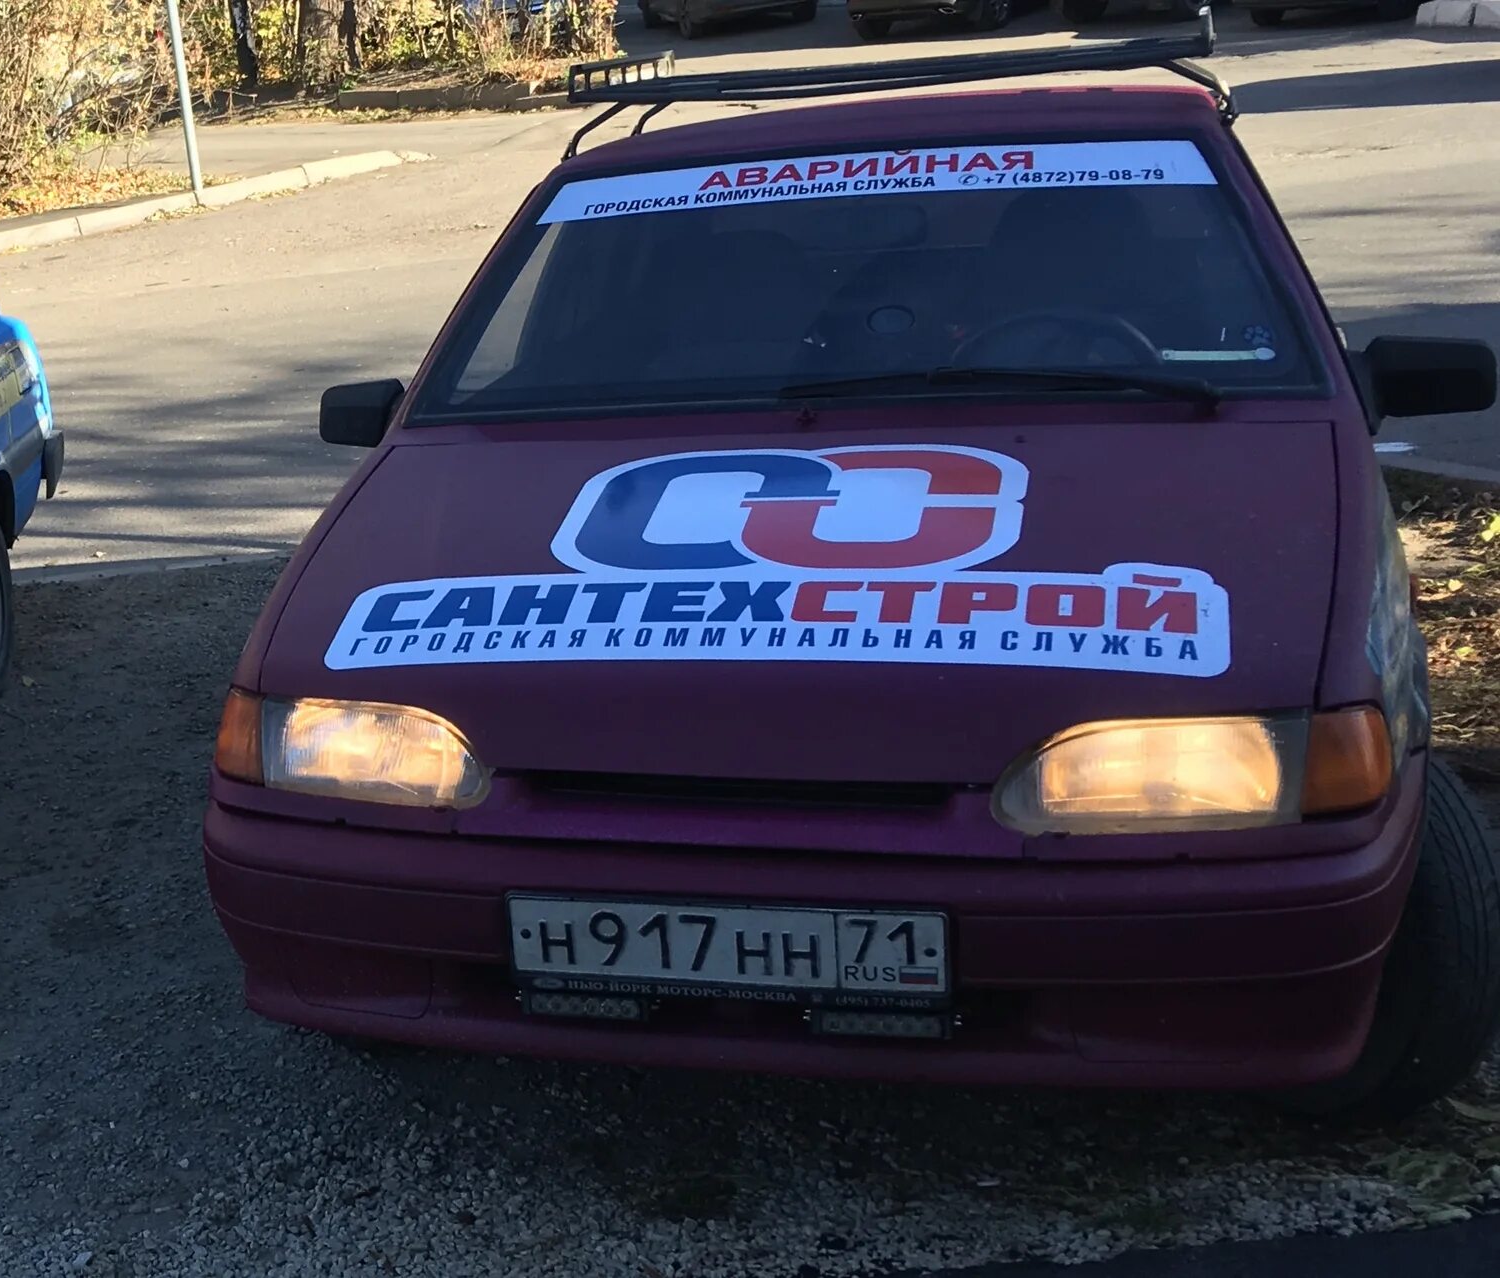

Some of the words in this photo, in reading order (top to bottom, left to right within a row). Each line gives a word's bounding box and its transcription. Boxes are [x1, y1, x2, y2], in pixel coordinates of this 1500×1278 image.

[699, 150, 1034, 190] АВАРИЙНАЯ
[584, 195, 689, 216] ГОРОДСКАЯ
[694, 181, 847, 204] КОММУНАЛЬНАЯ
[853, 177, 936, 192] СЛУЖБА
[984, 173, 1005, 184] +7
[362, 573, 1198, 635] САНТЕХСТРОЙ
[349, 628, 587, 656] ГОРОДСКАЯ
[605, 627, 977, 652] КОММУНАЛЬНАЯ
[1000, 631, 1200, 661] СЛУЖБА
[846, 919, 917, 965] 71
[844, 965, 897, 982] RUS
